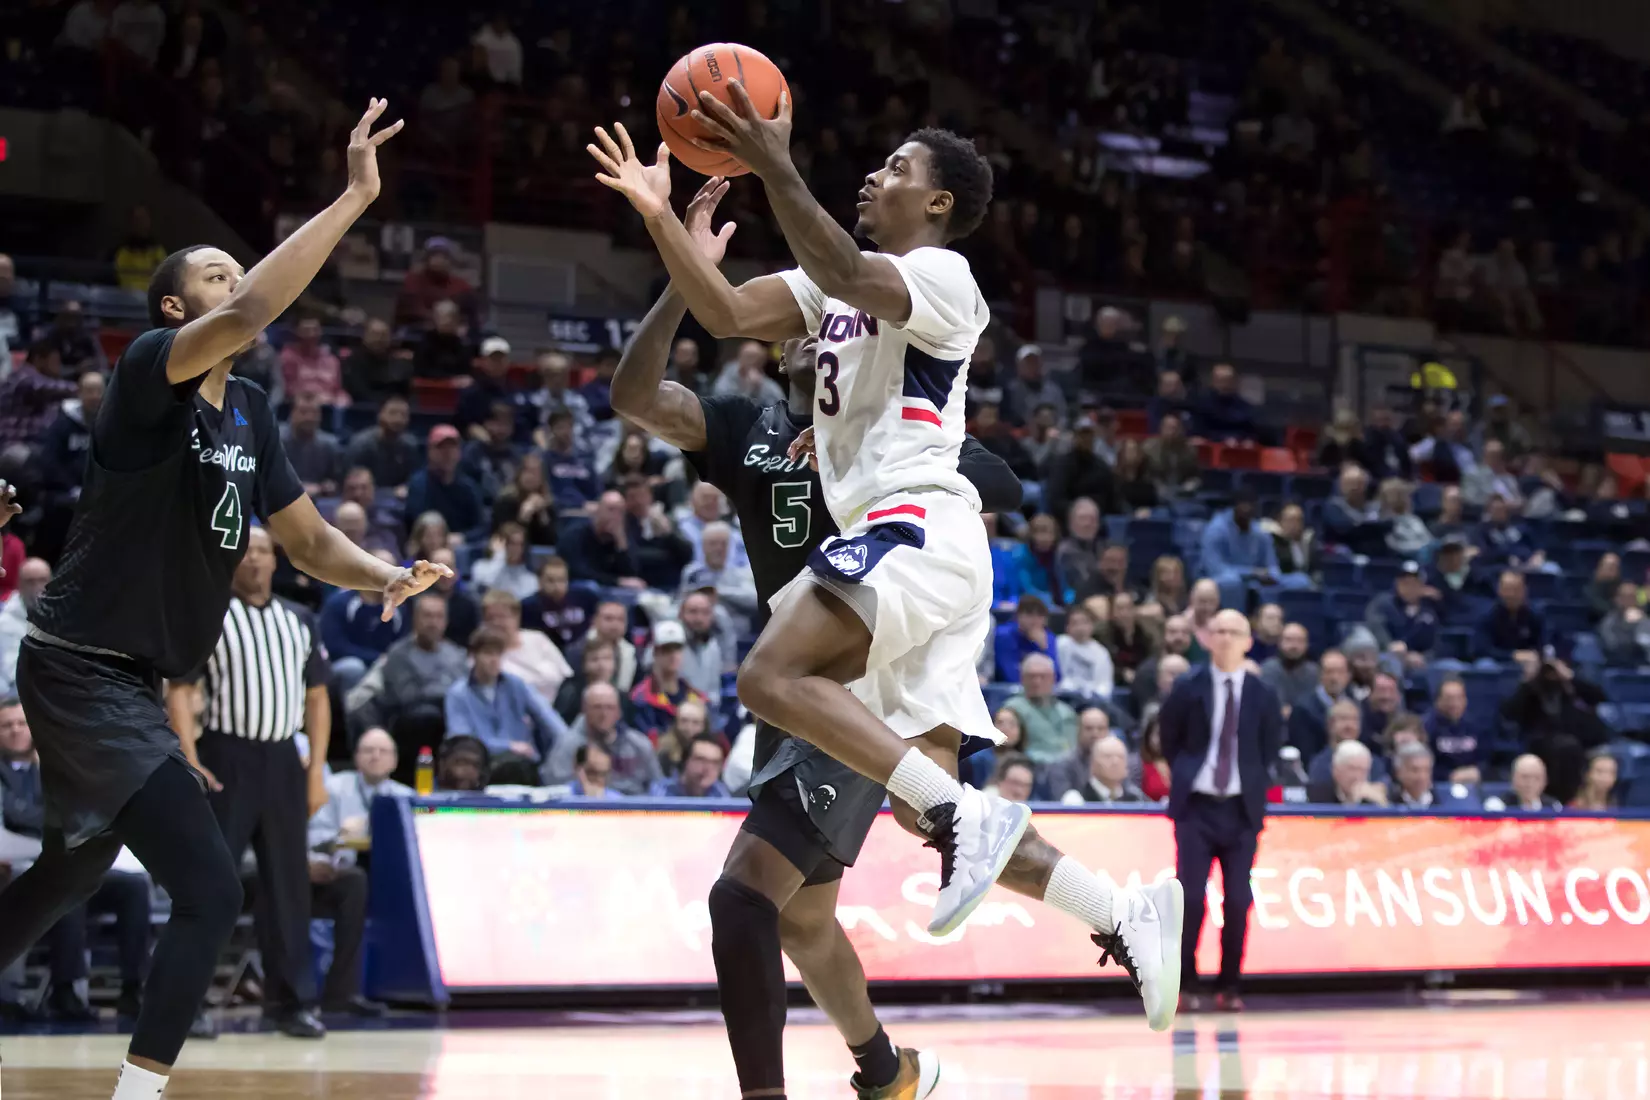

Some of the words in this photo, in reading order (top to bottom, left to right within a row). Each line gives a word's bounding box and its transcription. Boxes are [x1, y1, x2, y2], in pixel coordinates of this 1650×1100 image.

[817, 351, 840, 417] 3
[211, 481, 243, 550] 4
[772, 481, 812, 548] 5
